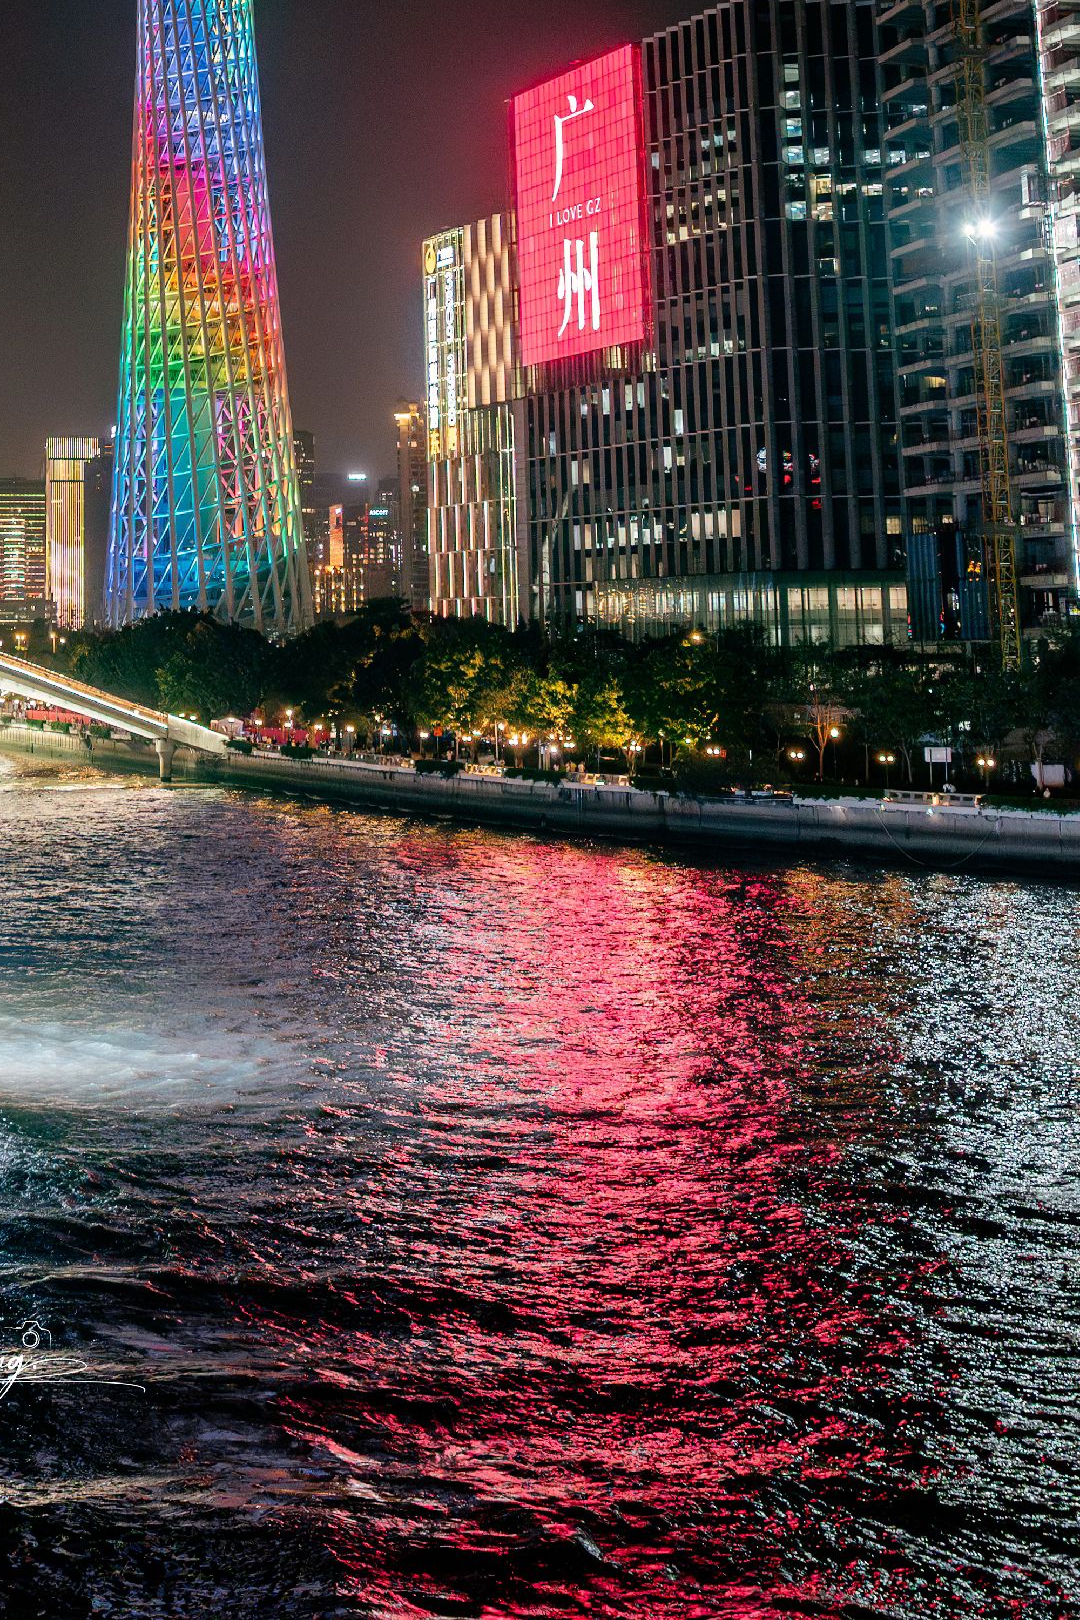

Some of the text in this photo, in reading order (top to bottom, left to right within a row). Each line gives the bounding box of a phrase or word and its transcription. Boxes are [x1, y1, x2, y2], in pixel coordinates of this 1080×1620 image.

[551, 95, 595, 202] 广
[549, 197, 601, 228] I LOVE GZ
[557, 231, 601, 337] 州
